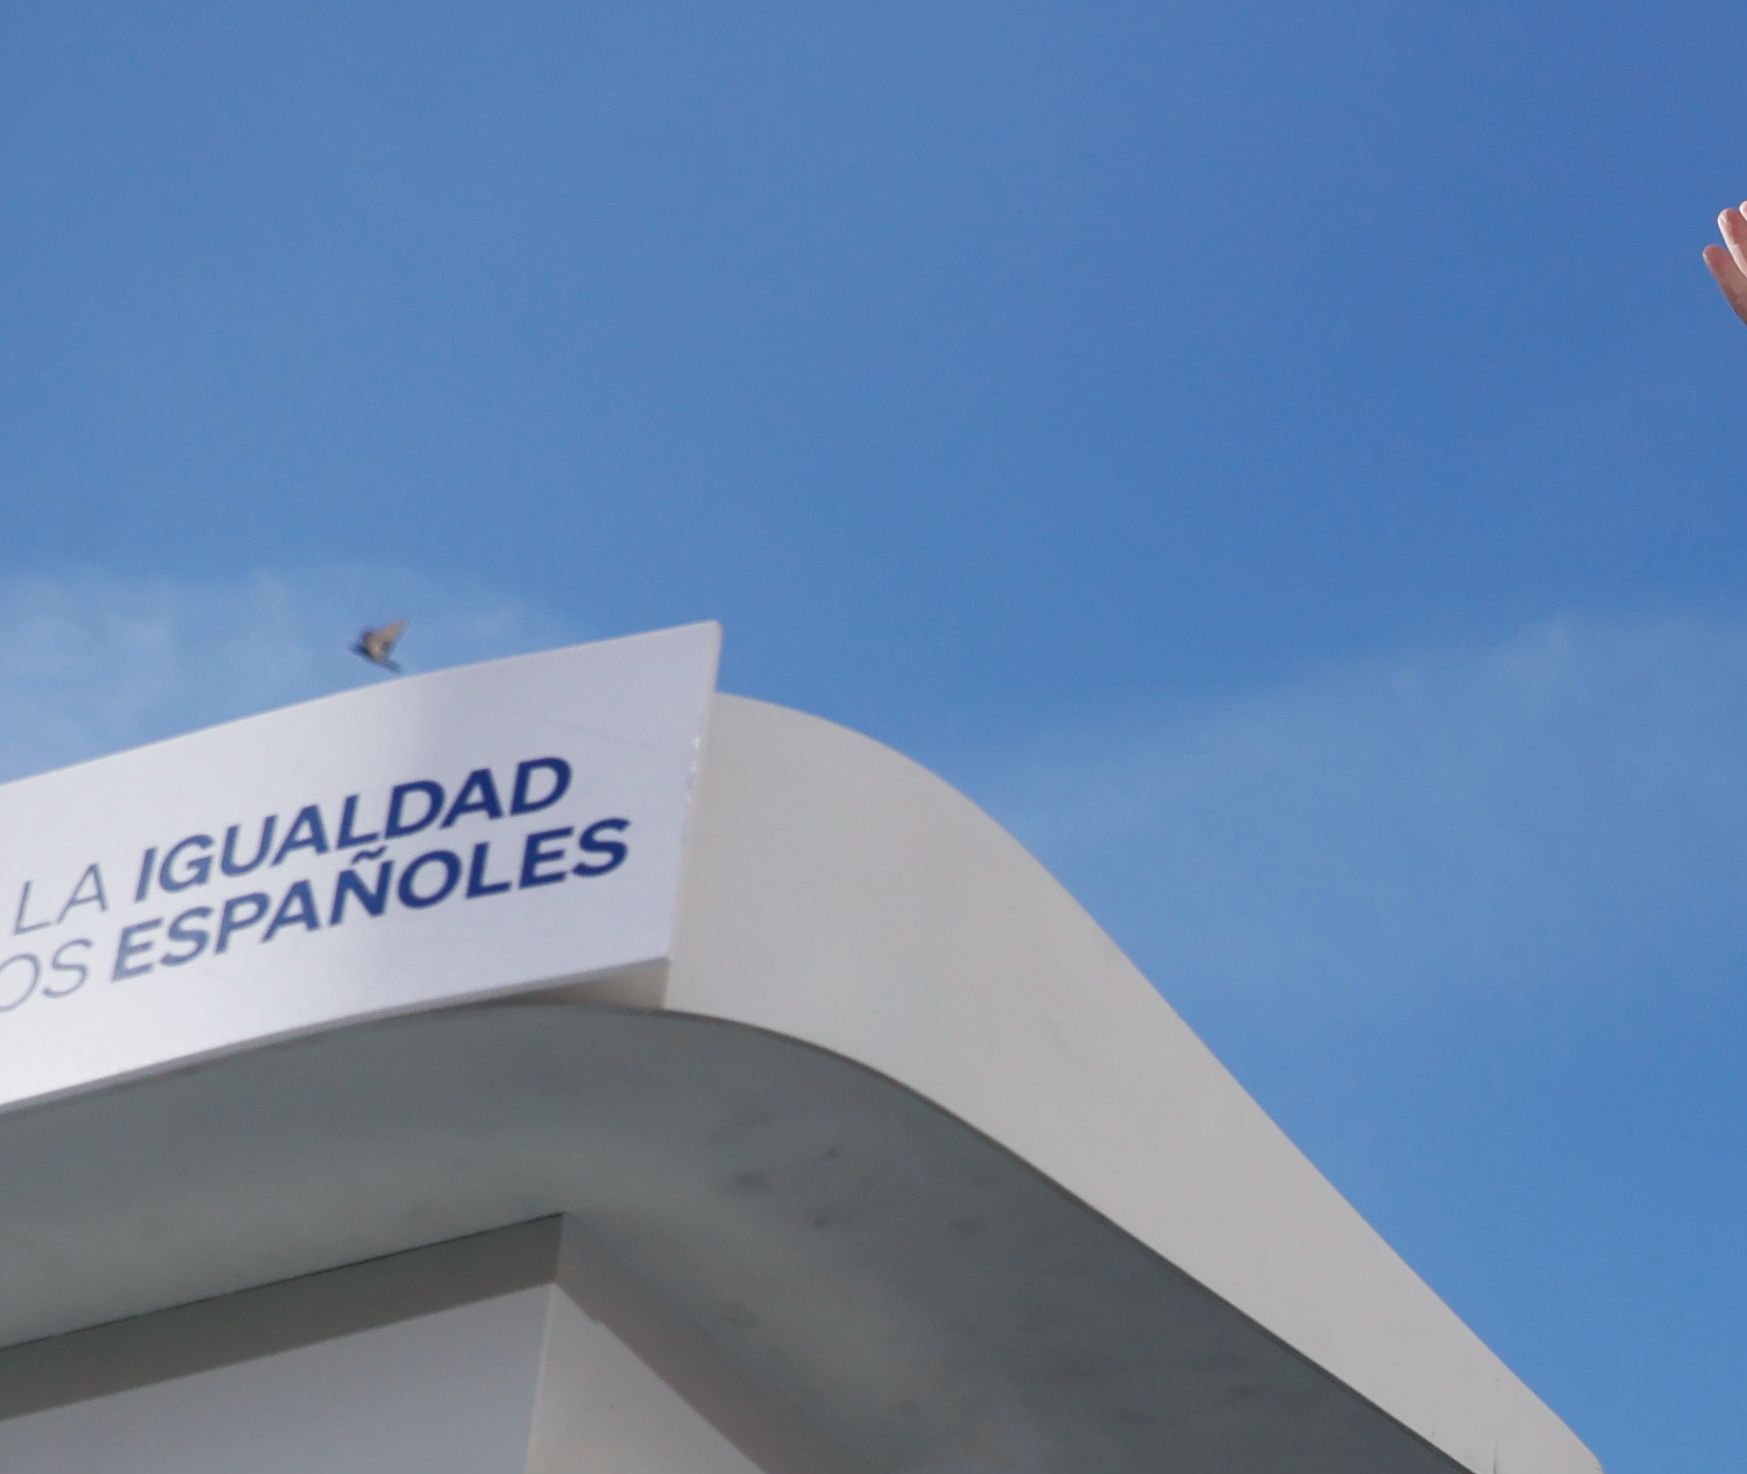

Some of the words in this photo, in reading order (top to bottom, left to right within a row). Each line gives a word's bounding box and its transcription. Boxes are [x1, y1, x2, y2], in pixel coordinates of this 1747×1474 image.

[14, 861, 109, 936] LA
[134, 756, 573, 904] IGUALDAD
[110, 817, 631, 984] ESPAÑOLES
